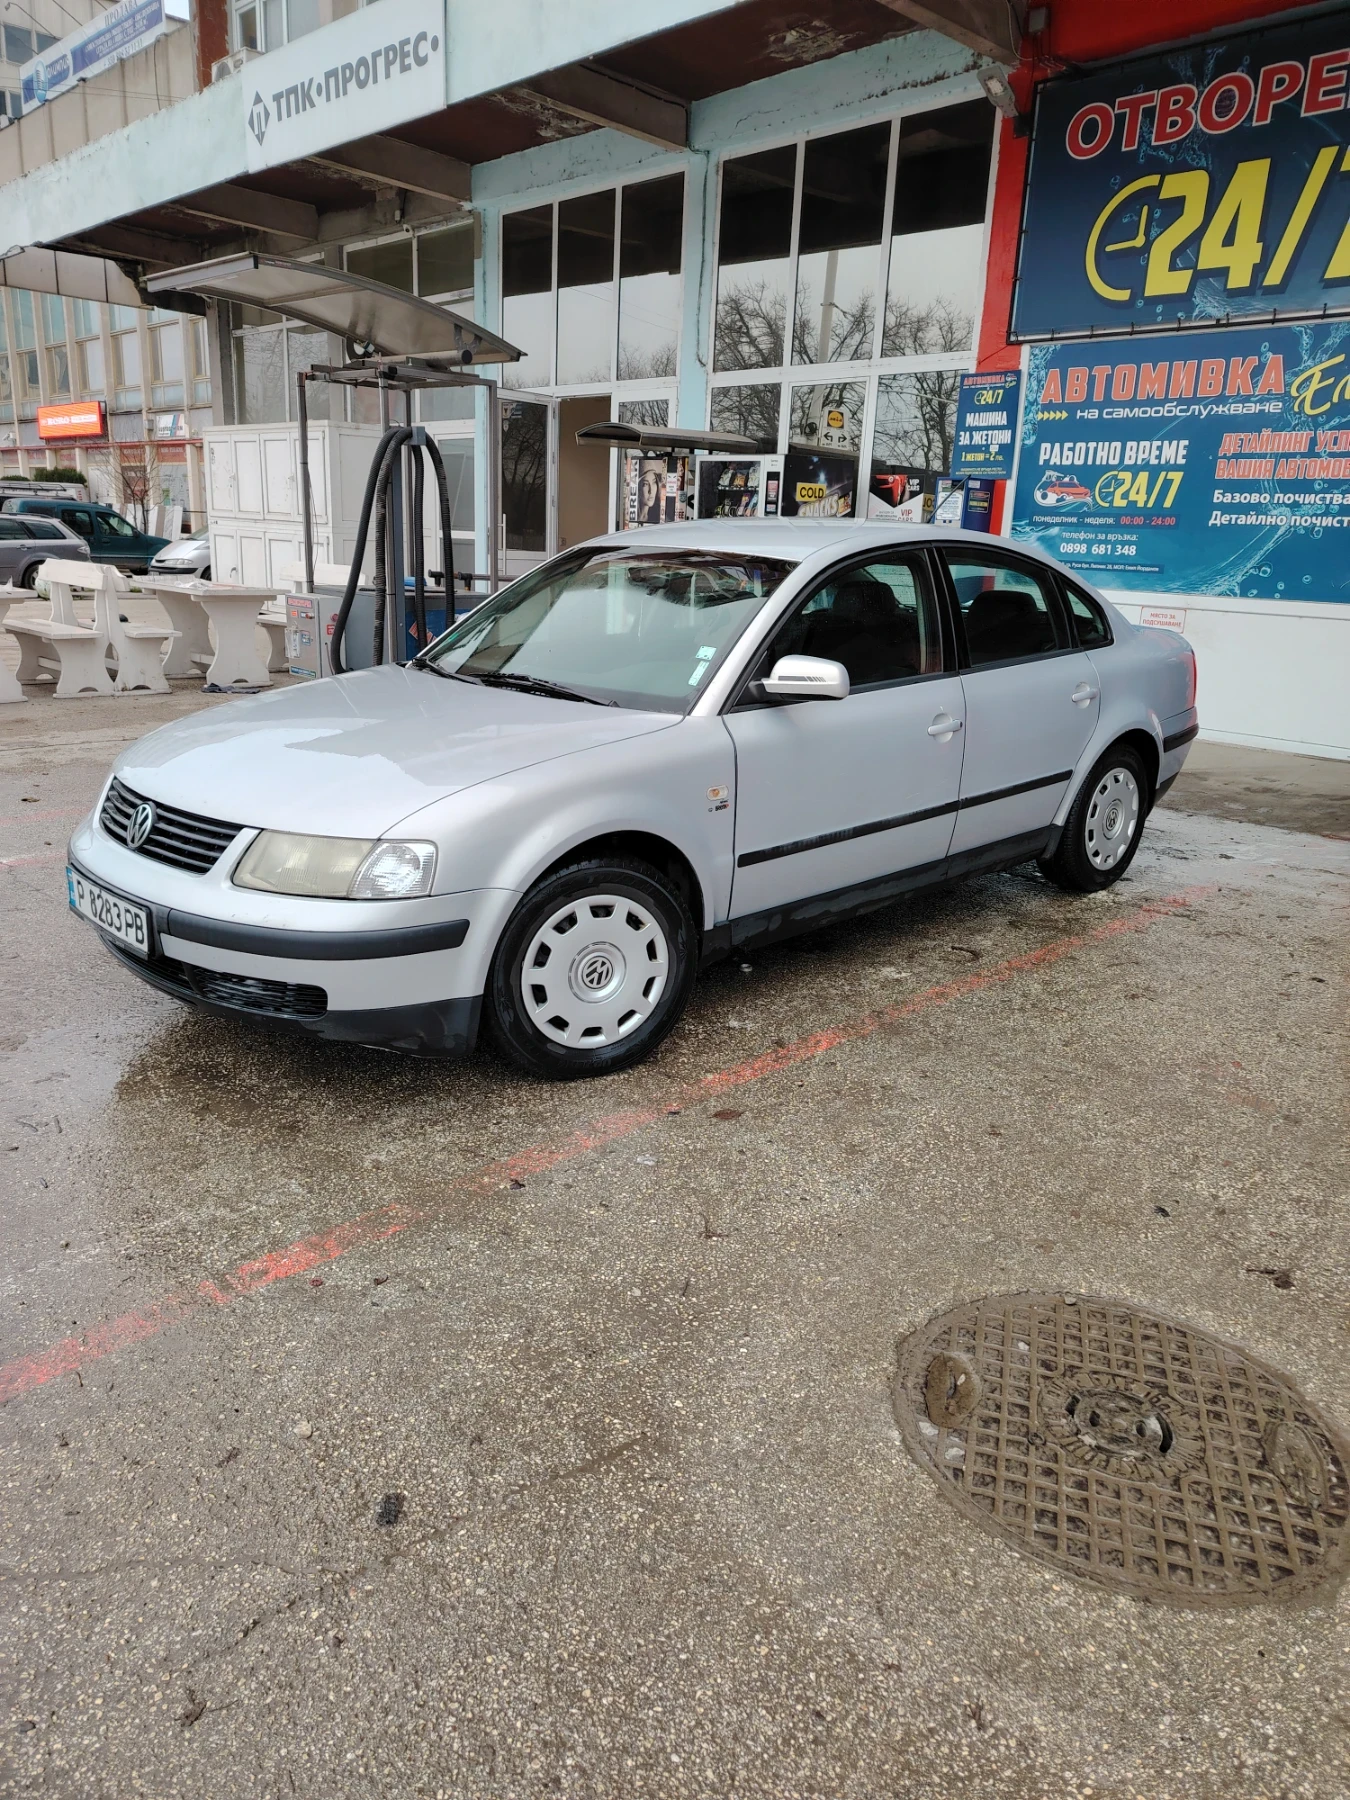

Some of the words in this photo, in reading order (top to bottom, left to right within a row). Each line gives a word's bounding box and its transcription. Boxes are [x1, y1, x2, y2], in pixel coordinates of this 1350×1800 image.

[1066, 47, 1350, 160] ОТВОРЕ
[1040, 354, 1285, 404] АВТОМИВКА
[1076, 409, 1099, 420] на
[1103, 401, 1283, 419] самообслужване
[965, 411, 1007, 427] МАШИНА
[958, 431, 970, 445] ЗА
[971, 430, 1012, 445] ЖЕТОНИ
[1218, 428, 1314, 456] ДЕТАЙЛИНГ
[1315, 430, 1350, 452] УСЛ
[1039, 441, 1122, 465] РАБОТНО
[1124, 440, 1189, 465] ВРЕМЕ
[1215, 459, 1275, 479] ВАШИЯ
[799, 487, 824, 499] COLD
[1113, 471, 1184, 508] 24/7
[1213, 490, 1270, 504] Базово
[1032, 515, 1078, 525] понеделник
[1120, 516, 1144, 525] 00:00
[1151, 517, 1176, 526] 24:00
[1208, 511, 1287, 527] Детайлно
[1062, 531, 1095, 541] телефон
[1060, 543, 1087, 553] 0898
[1091, 543, 1112, 555] 681
[1114, 544, 1137, 556] 348
